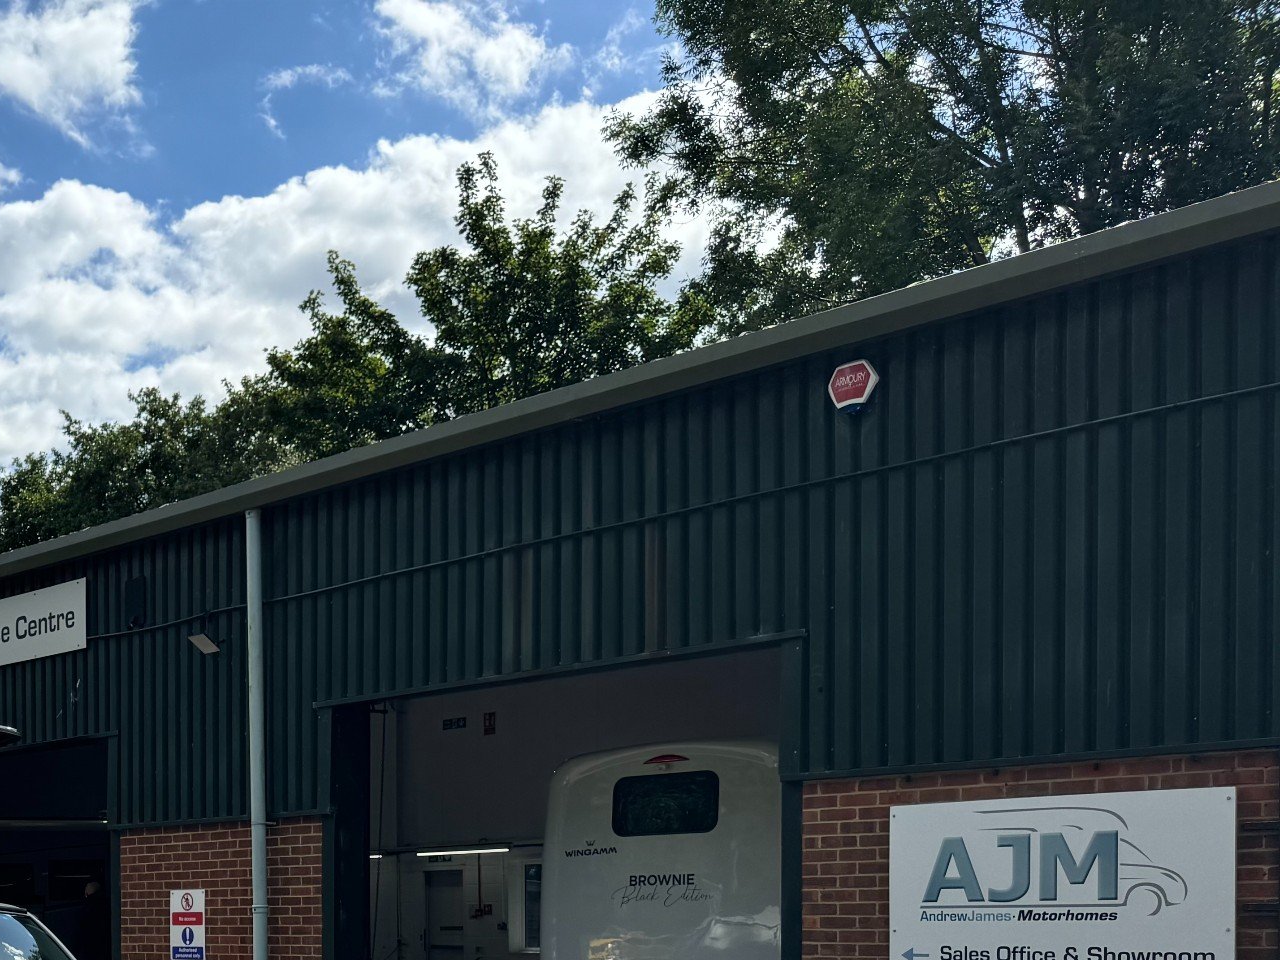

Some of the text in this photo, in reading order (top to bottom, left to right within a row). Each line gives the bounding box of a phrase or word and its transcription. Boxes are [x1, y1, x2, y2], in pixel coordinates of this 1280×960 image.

[835, 372, 866, 387] ARMOURY
[15, 610, 75, 640] Centre
[565, 847, 618, 858] WINGAMM
[921, 830, 1119, 903] AJM
[629, 874, 695, 887] BROWNIE
[611, 884, 714, 908] Black Edition
